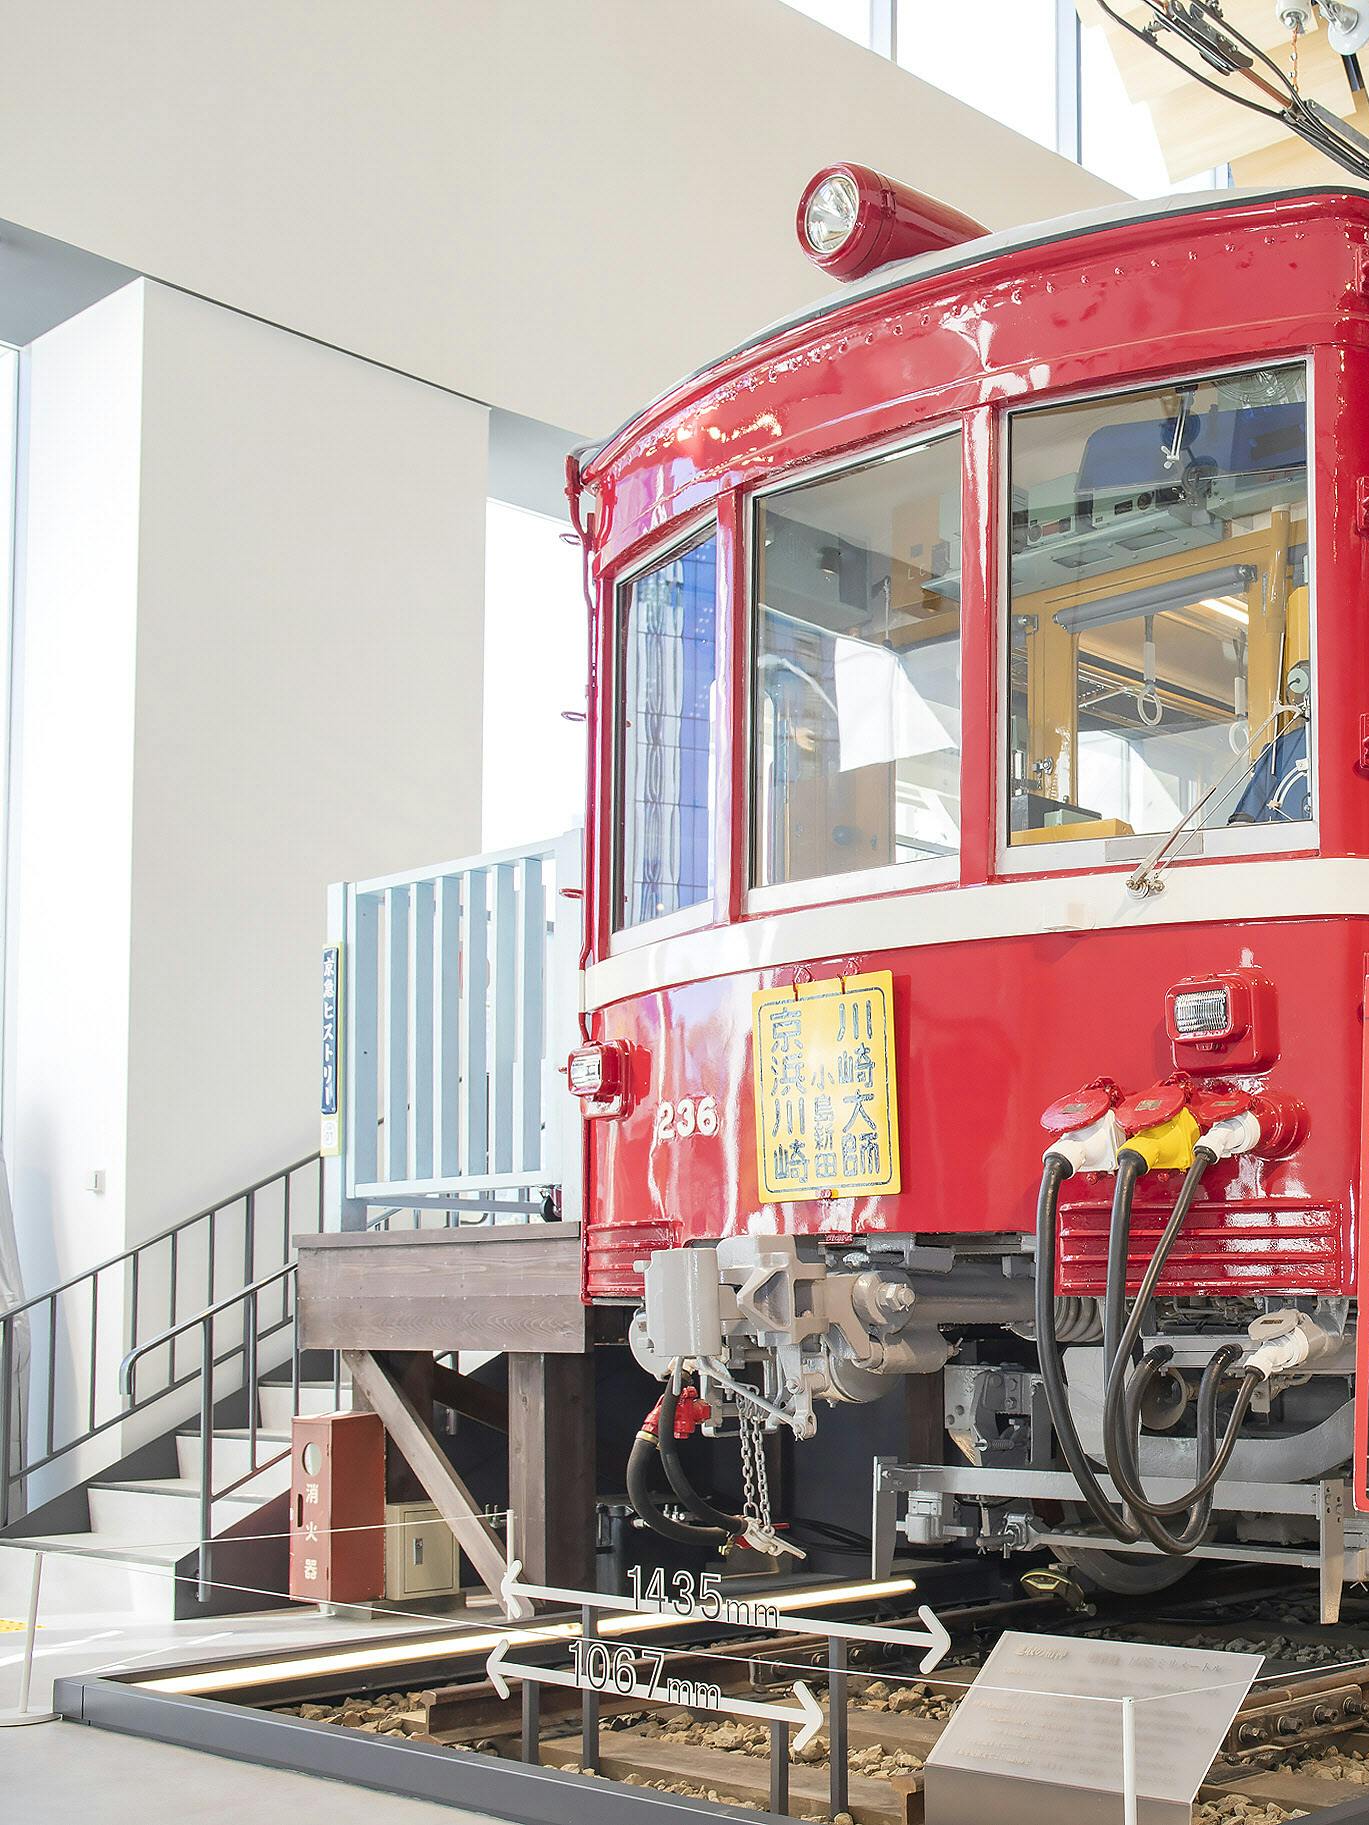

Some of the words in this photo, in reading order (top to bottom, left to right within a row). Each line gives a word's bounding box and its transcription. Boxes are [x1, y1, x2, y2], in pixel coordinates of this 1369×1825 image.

[322, 957, 335, 1106] 京急ヒストリー
[769, 1006, 810, 1184] 京浜川崎
[836, 998, 881, 1178] 川崎大師
[657, 1096, 718, 1139] 236
[811, 1064, 838, 1179] 小島新田
[304, 1483, 320, 1580] 消火器
